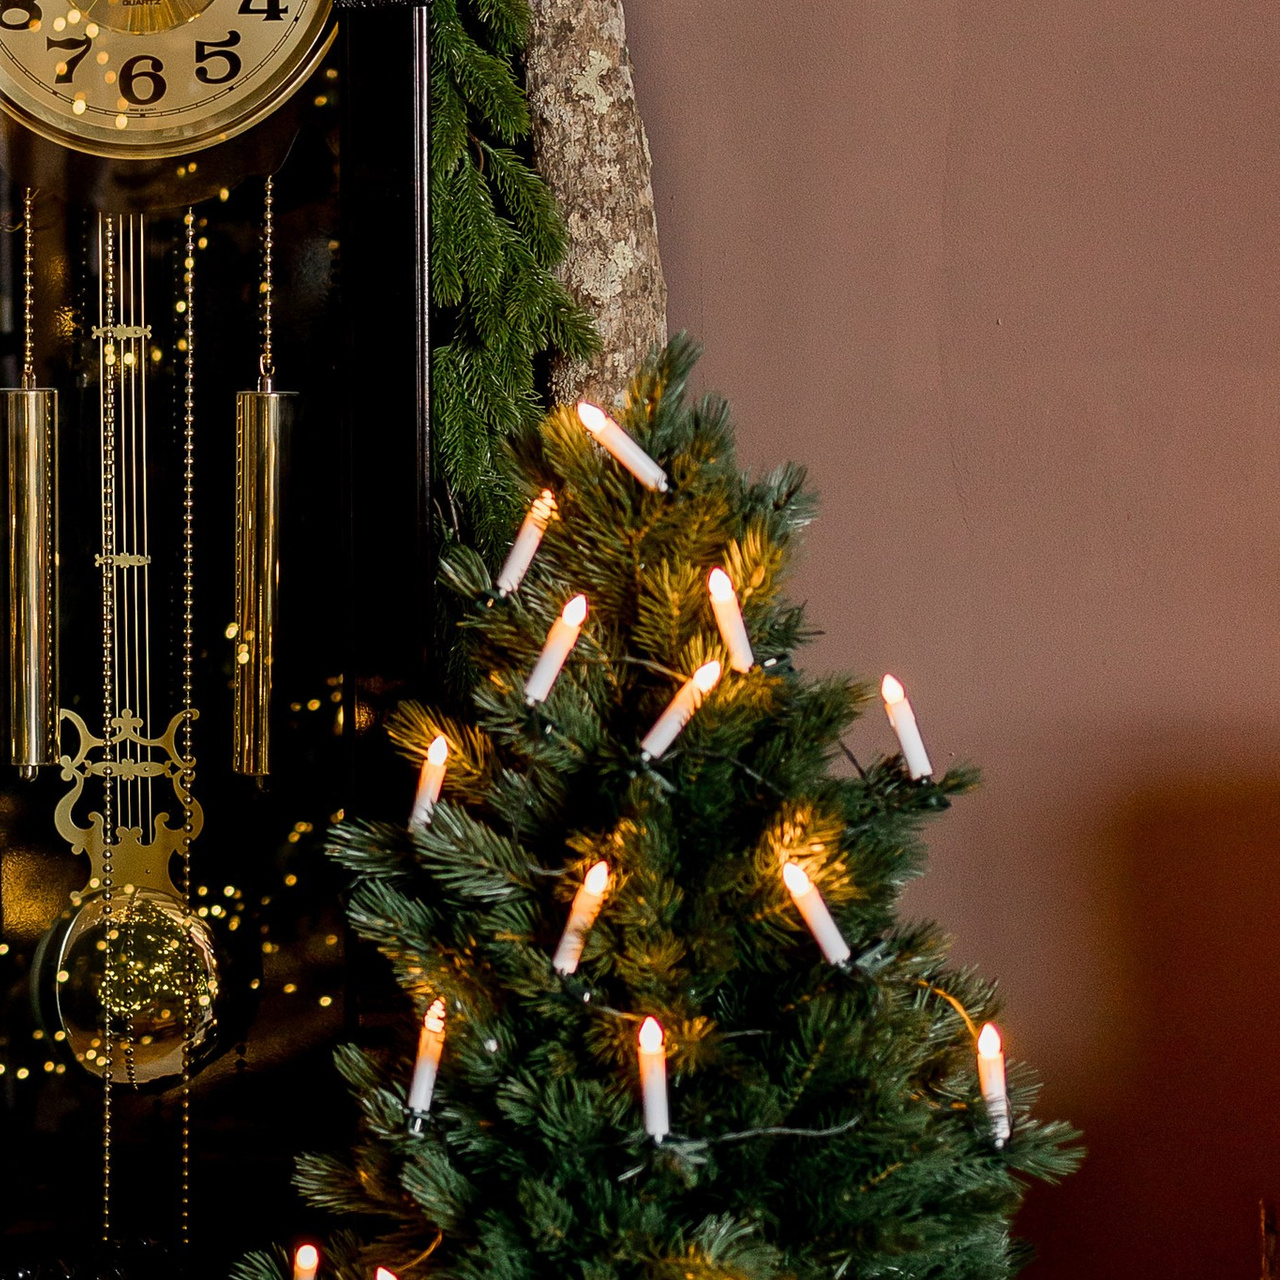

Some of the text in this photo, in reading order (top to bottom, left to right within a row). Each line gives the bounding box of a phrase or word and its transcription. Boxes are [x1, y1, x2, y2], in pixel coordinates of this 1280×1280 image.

[46, 32, 94, 84] 7
[119, 54, 167, 105] 6
[195, 30, 241, 84] 5
